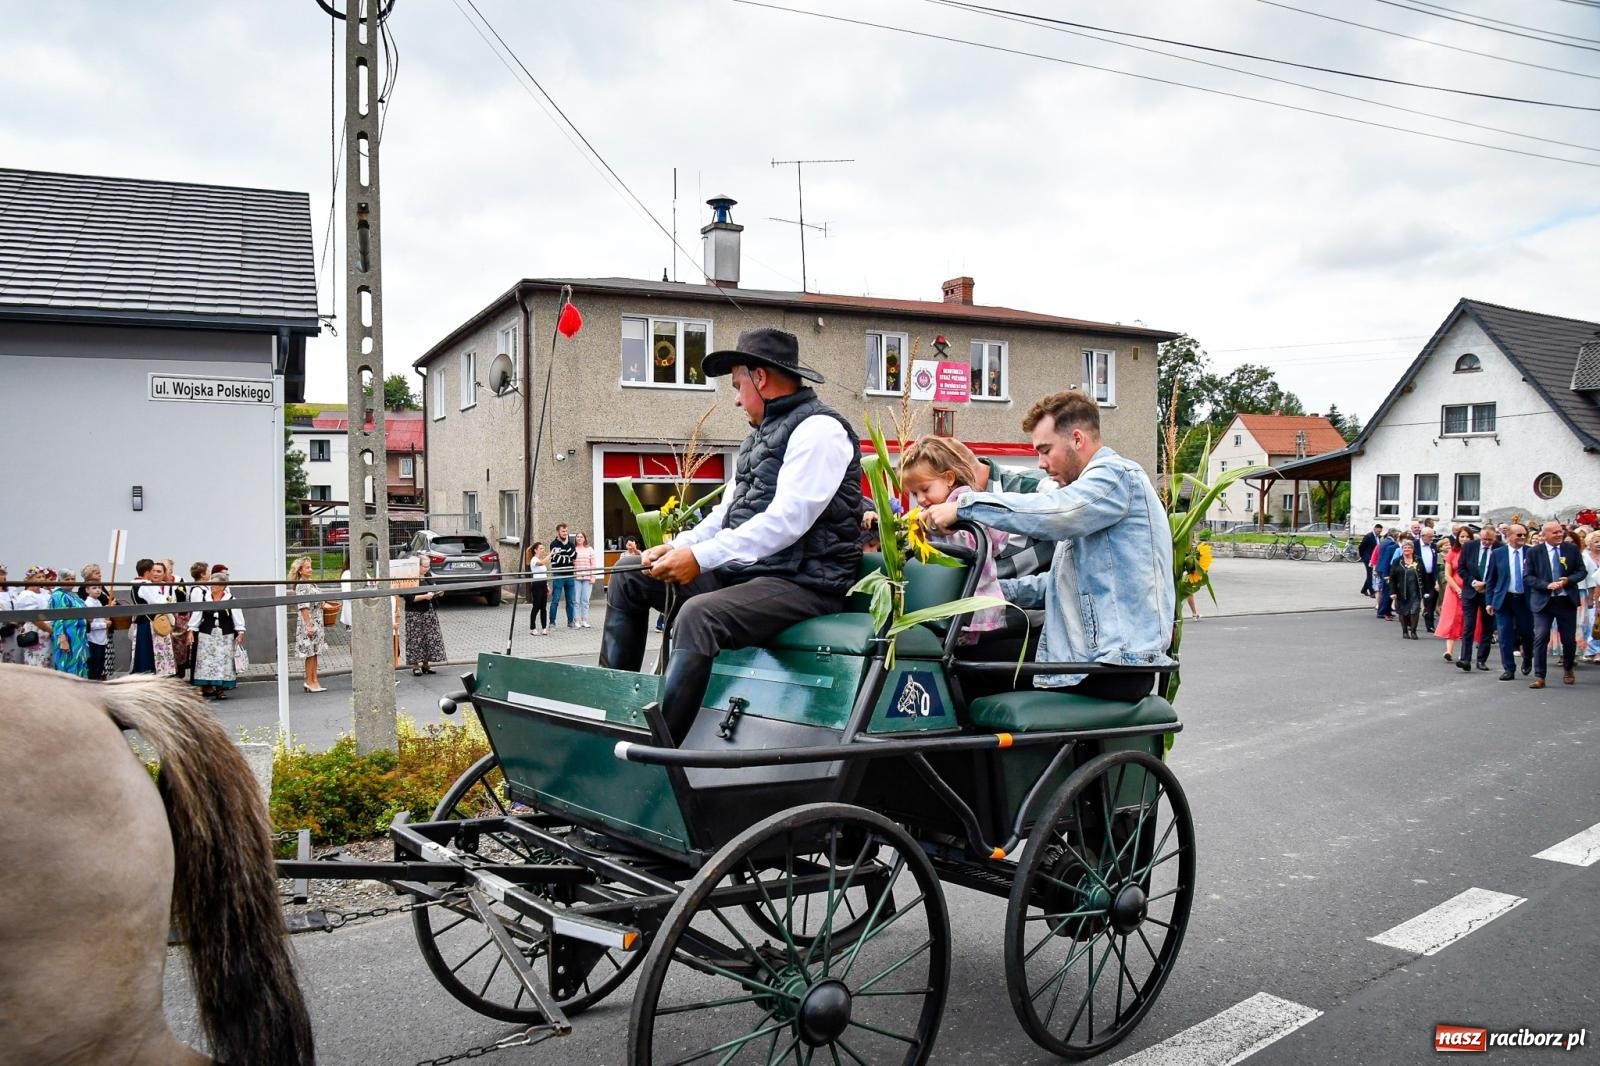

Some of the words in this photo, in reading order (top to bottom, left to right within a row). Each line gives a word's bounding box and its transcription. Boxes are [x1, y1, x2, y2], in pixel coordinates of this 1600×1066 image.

[155, 381, 169, 394] ul.
[172, 382, 213, 399] Wojska
[217, 384, 270, 402] Polskiego
